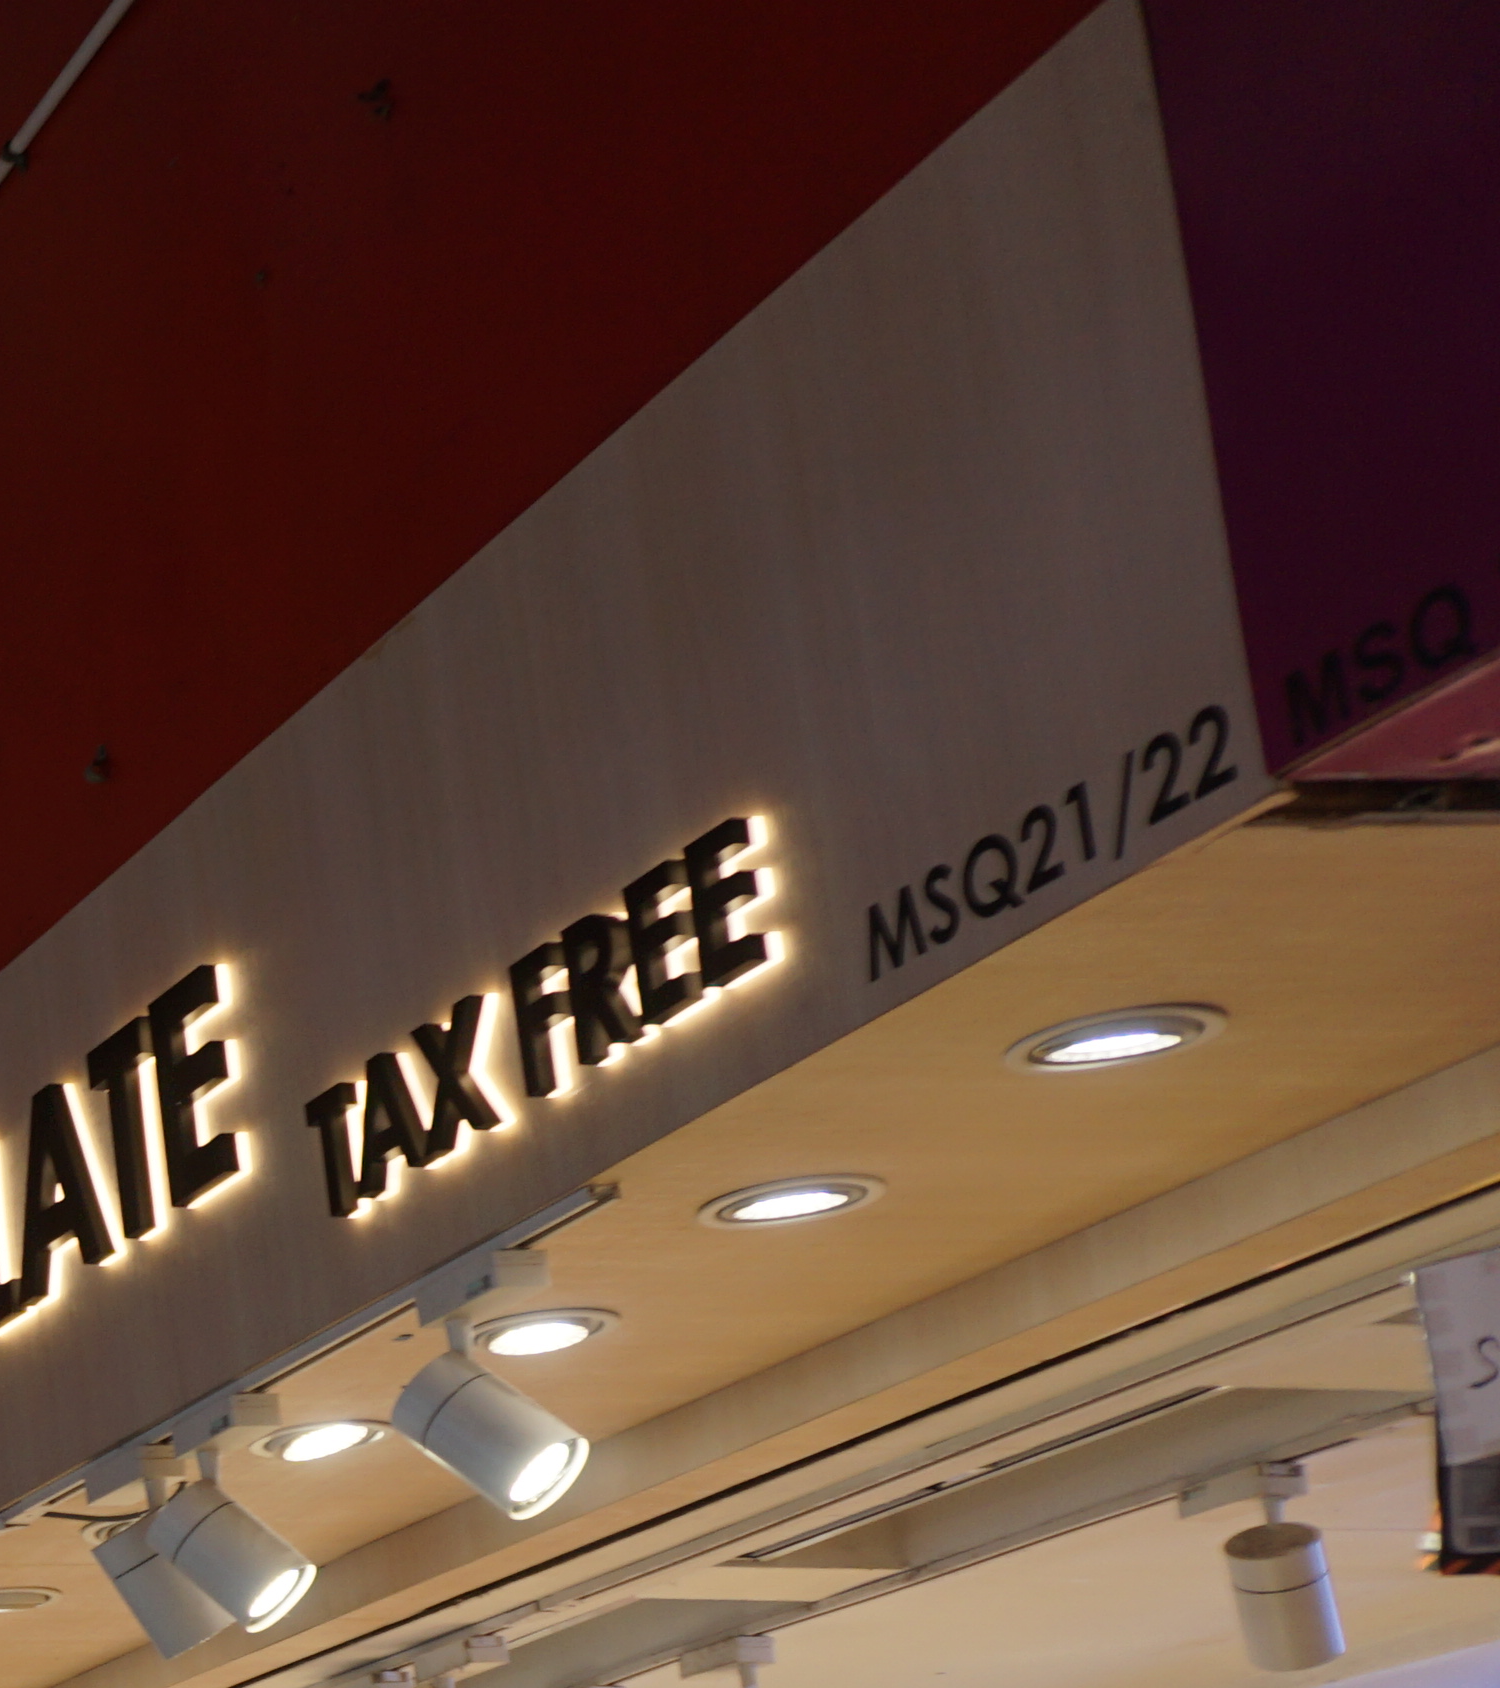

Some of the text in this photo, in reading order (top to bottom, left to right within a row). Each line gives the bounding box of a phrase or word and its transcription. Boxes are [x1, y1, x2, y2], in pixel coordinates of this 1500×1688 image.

[1281, 583, 1476, 744] MSQ
[867, 703, 1239, 982] MSQ21/22
[304, 815, 786, 1218] TAX FREE
